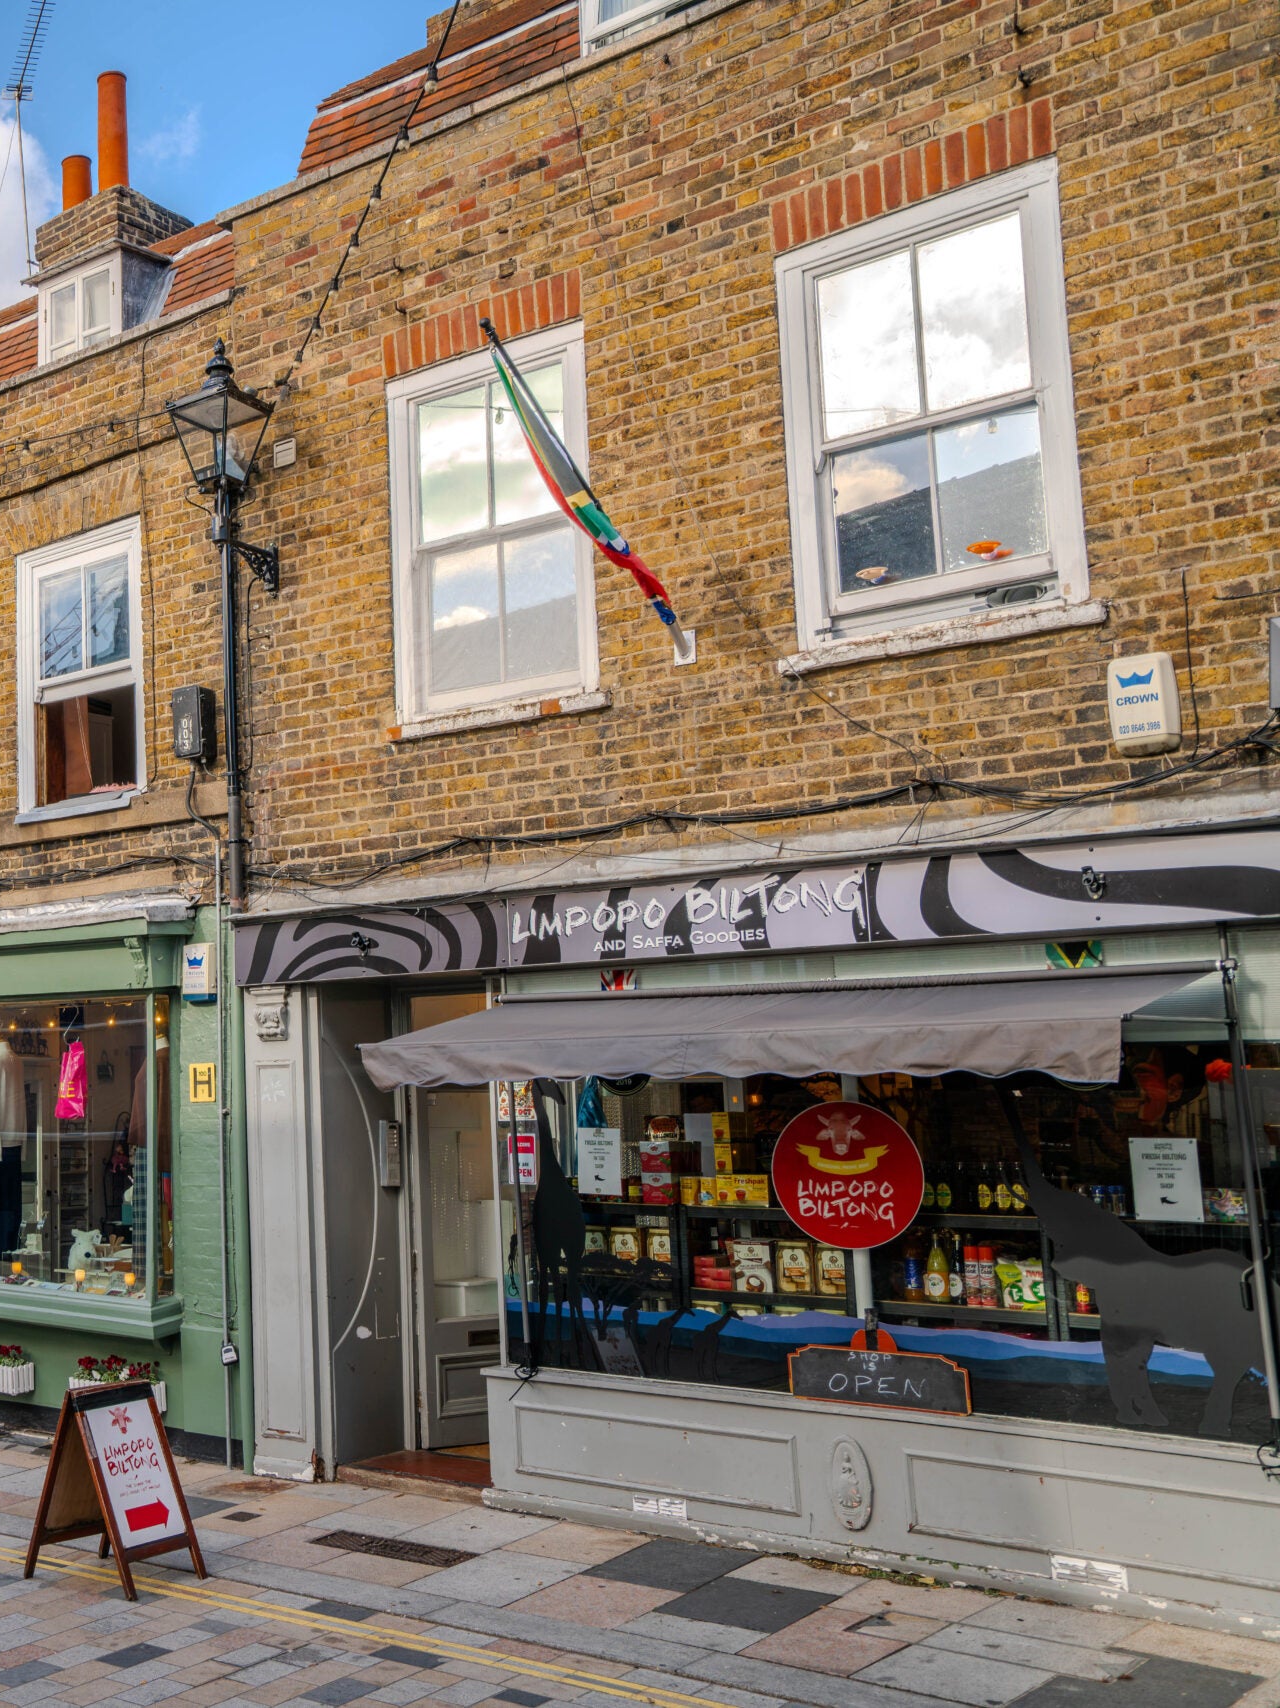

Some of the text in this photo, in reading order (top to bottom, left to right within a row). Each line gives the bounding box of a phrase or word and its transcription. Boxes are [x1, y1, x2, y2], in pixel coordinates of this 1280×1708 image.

[1116, 692, 1159, 707] CROWN
[1119, 724, 1130, 735] 020
[511, 874, 867, 944] LIMPOPO BILTONG
[193, 1067, 212, 1098] H
[518, 1108, 532, 1116] OCT
[1162, 1152, 1187, 1160] BILTONG
[519, 1168, 532, 1178] PEN
[797, 1179, 894, 1198] LIMPOPO
[798, 1197, 896, 1230] BILTONG
[847, 1351, 892, 1362] SHOP
[862, 1362, 877, 1372] IS
[828, 1373, 926, 1398] OPEN
[103, 1436, 154, 1462] LIMPOPO
[107, 1452, 163, 1477] BILTONG
